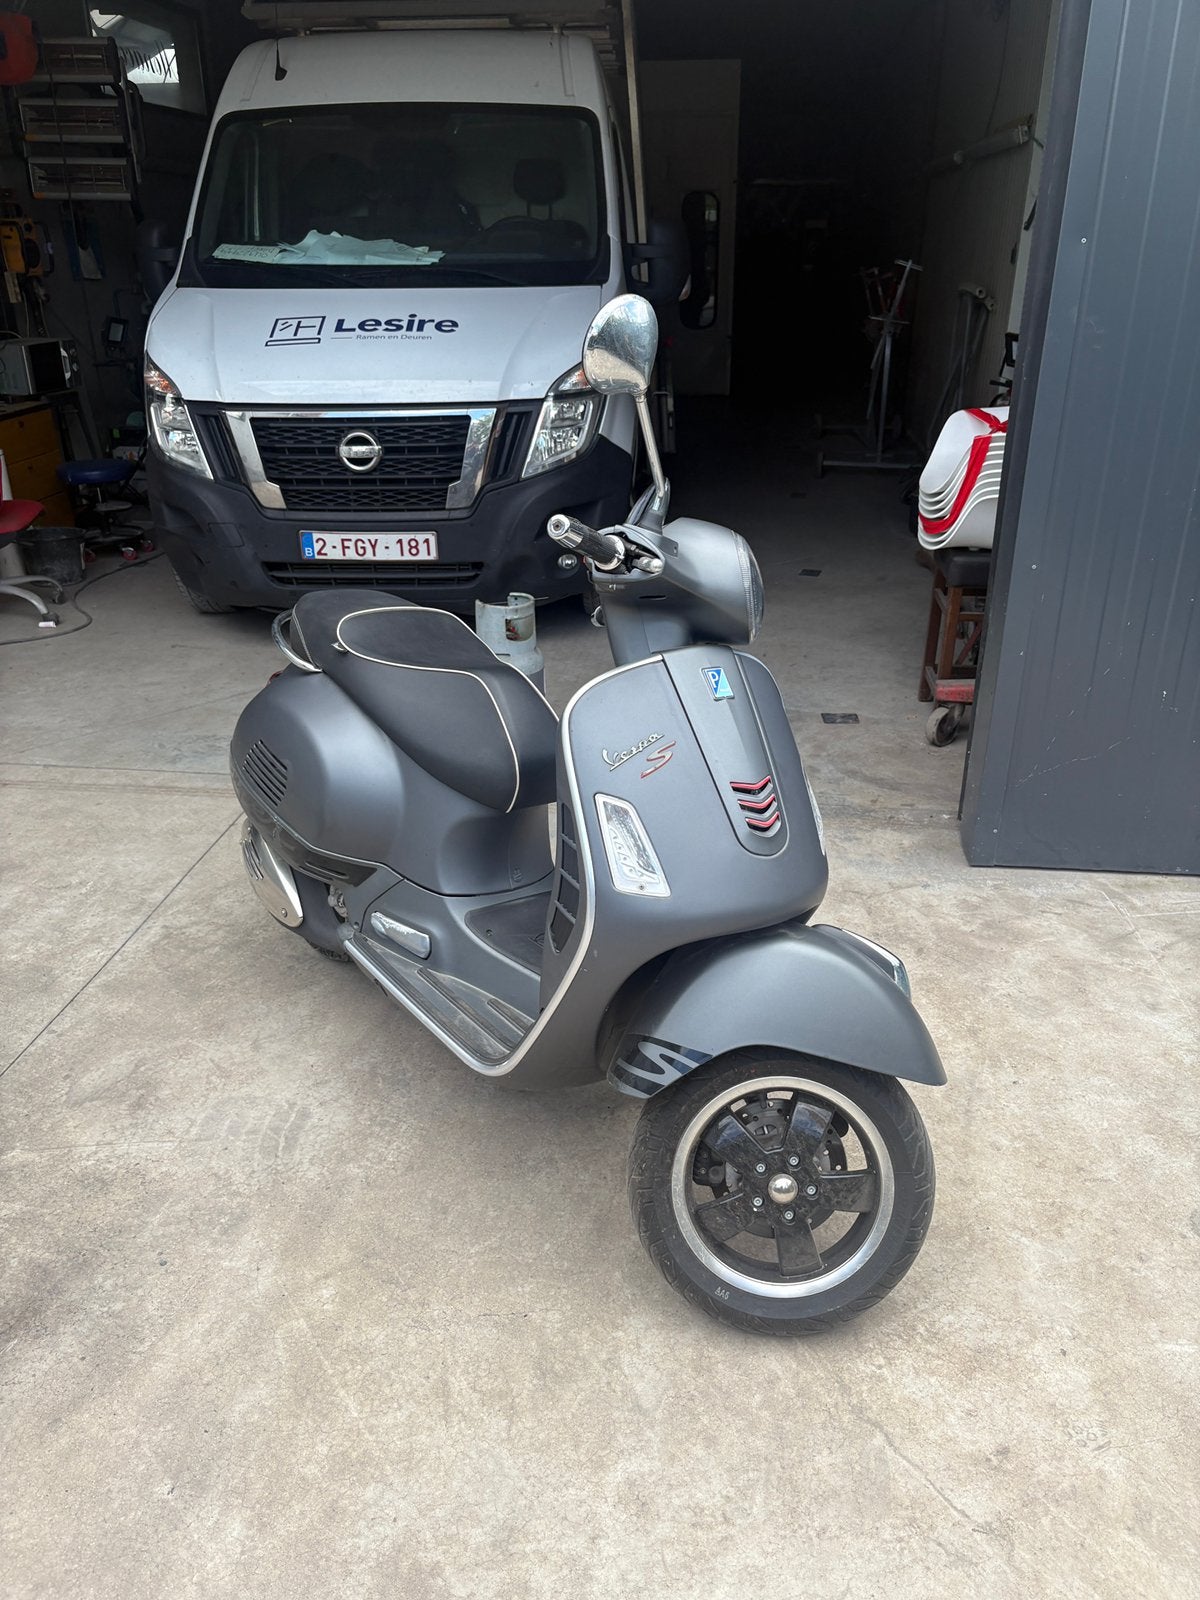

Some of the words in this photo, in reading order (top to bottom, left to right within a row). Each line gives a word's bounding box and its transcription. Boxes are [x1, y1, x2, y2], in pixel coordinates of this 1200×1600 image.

[334, 313, 459, 333] Lesire
[305, 547, 314, 557] B
[315, 537, 432, 557] 2-FGY-181
[602, 732, 665, 772] Vespa
[641, 740, 676, 778] S
